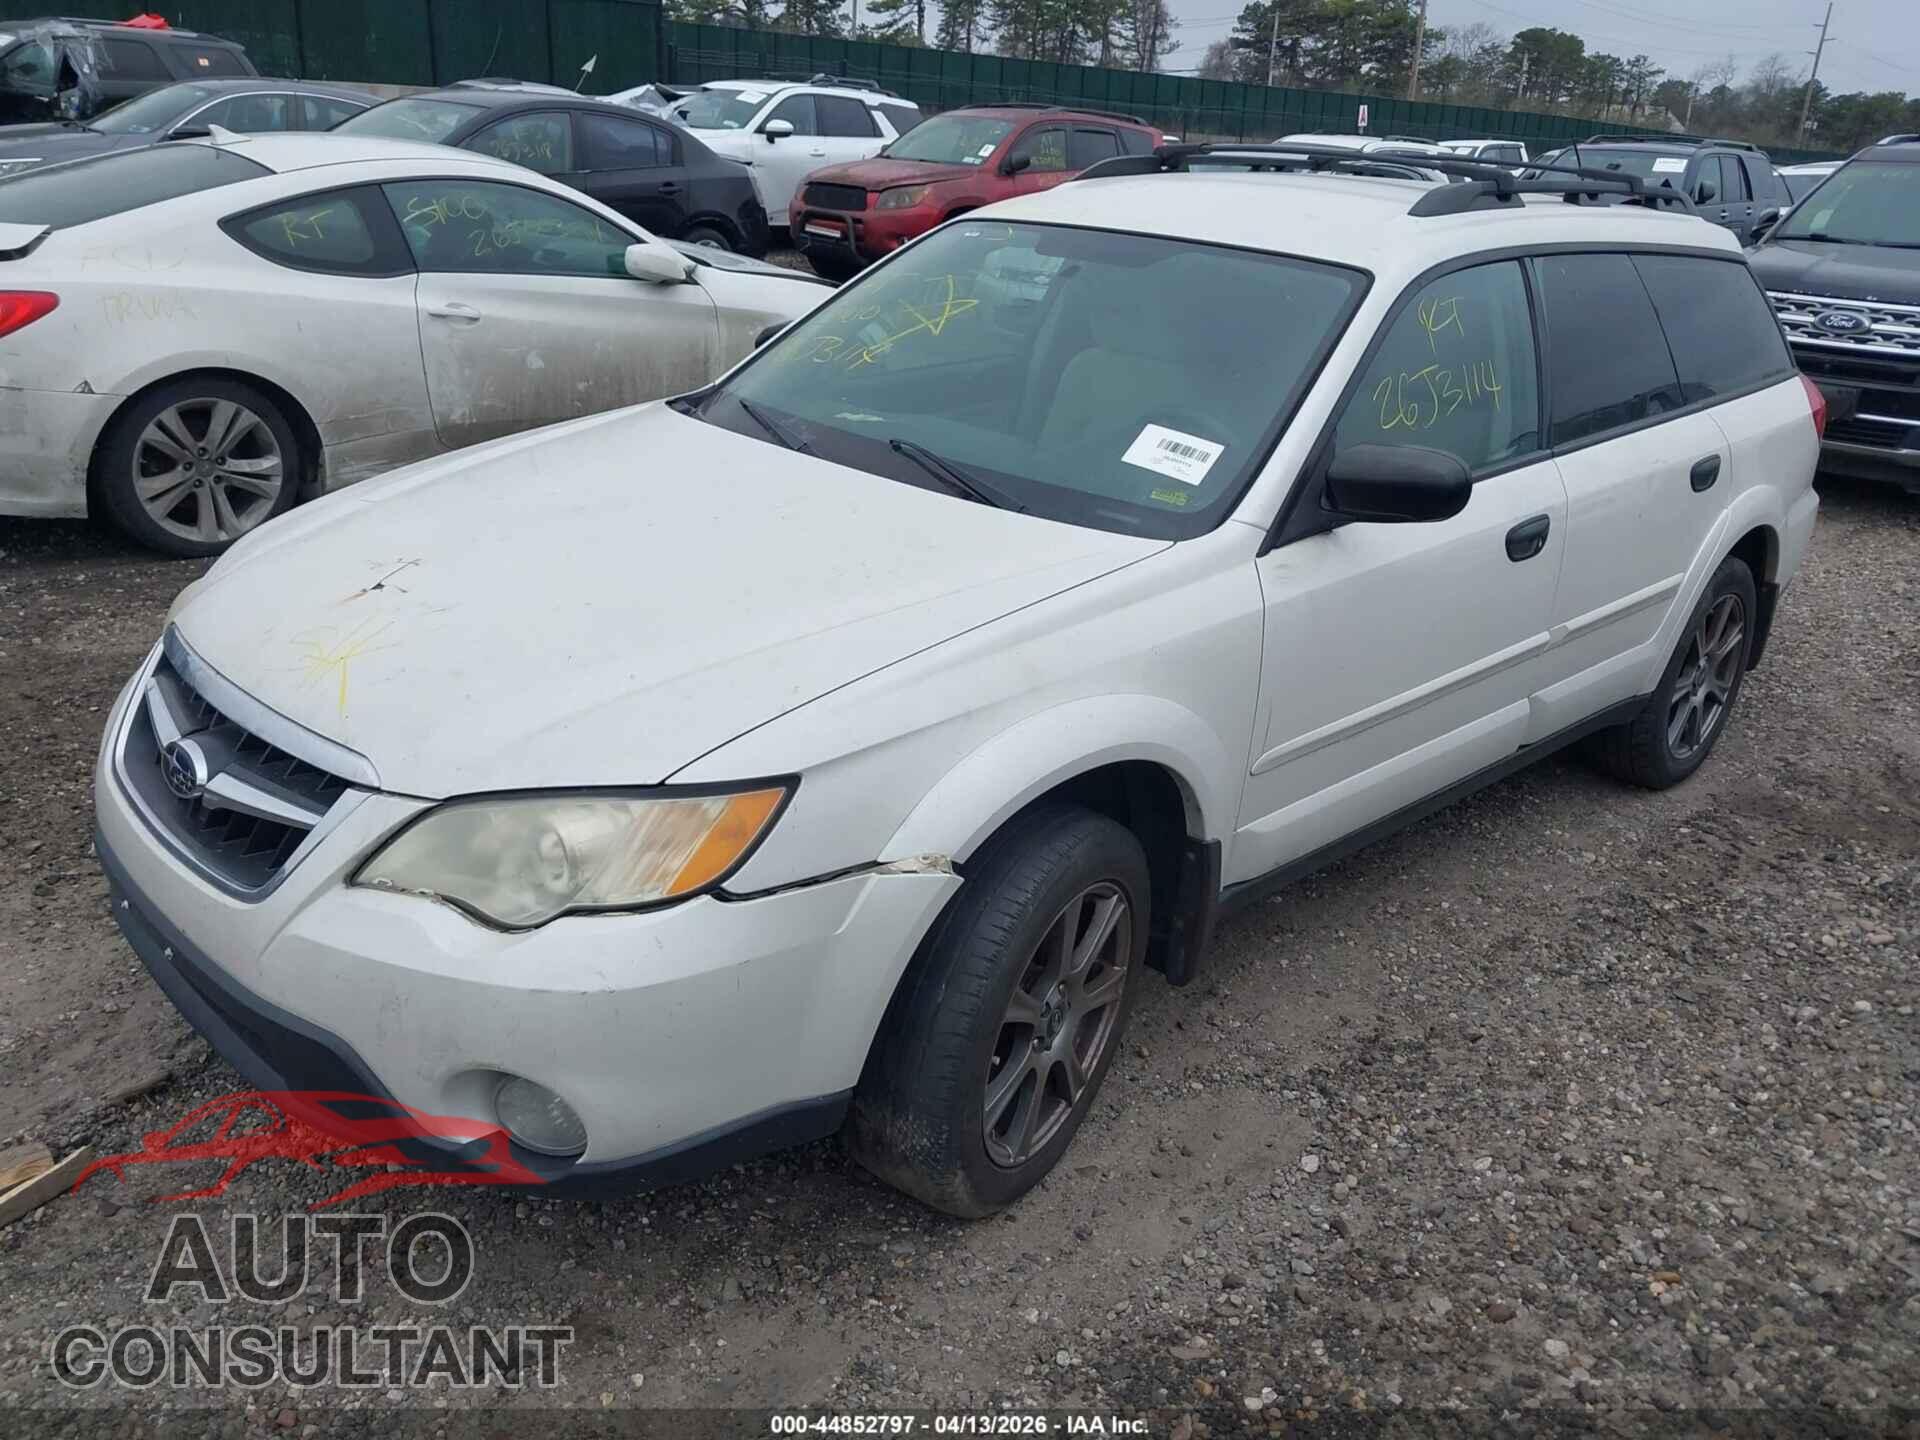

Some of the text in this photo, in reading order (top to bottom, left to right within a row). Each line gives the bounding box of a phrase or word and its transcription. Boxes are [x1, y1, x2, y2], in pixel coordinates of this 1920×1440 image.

[276, 207, 334, 248] RT
[1825, 314, 1857, 329] Ford
[1372, 359, 1503, 430] 26J3114
